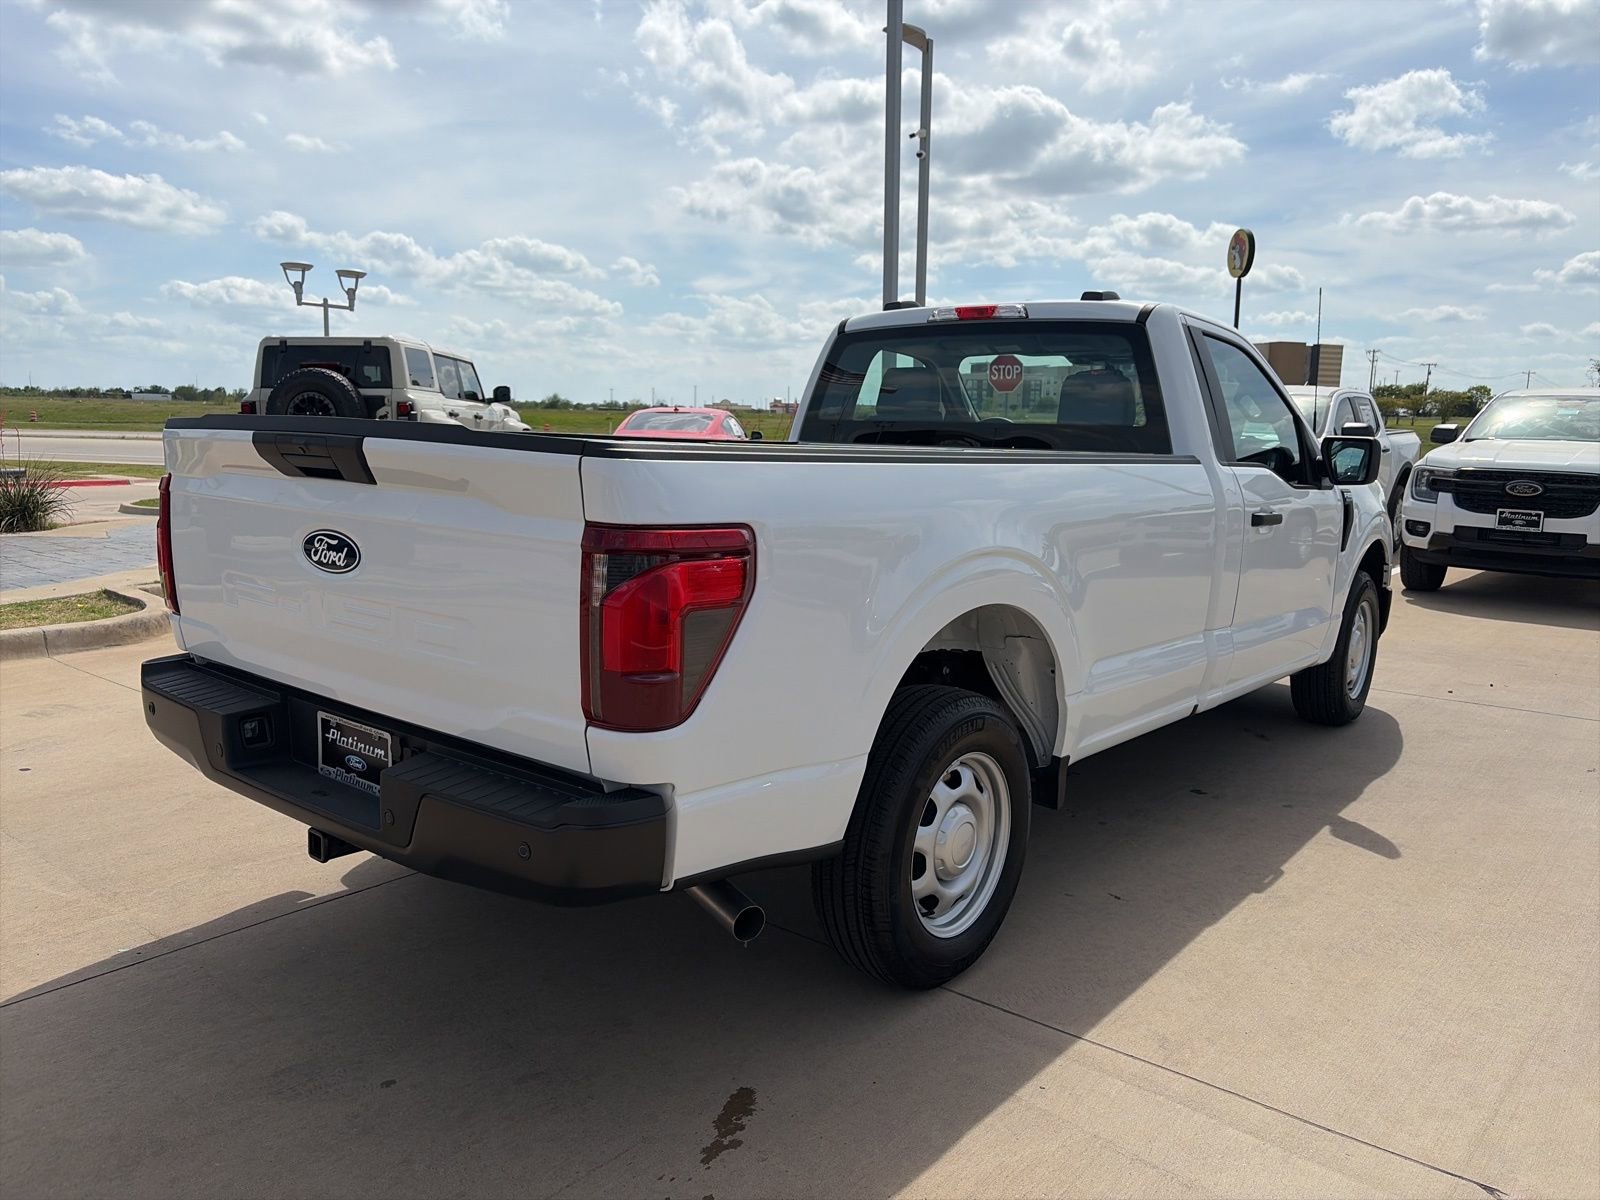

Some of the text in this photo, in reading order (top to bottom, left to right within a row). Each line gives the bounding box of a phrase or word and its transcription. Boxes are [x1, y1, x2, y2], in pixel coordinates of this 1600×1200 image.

[991, 365, 1021, 380] STOP
[1500, 512, 1539, 521] Platinum
[311, 535, 348, 567] Ford
[325, 728, 388, 761] Platinum
[335, 767, 375, 792] Platinum
